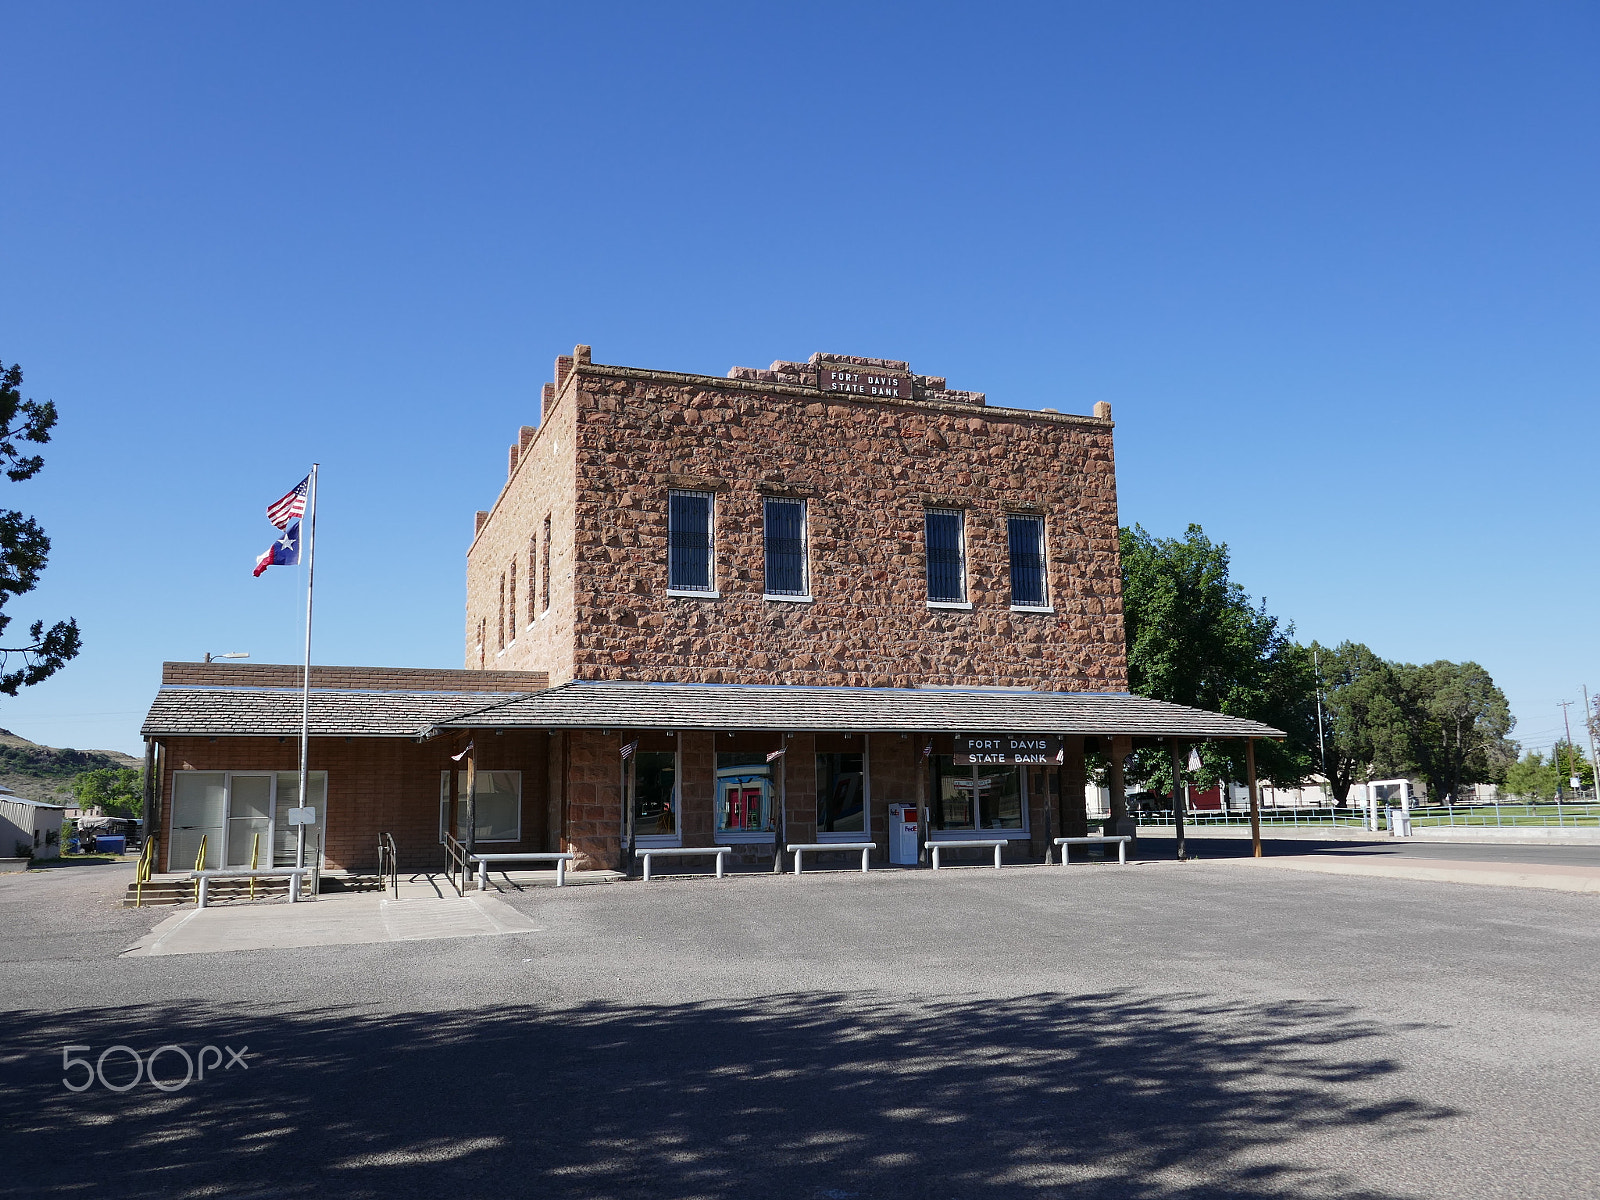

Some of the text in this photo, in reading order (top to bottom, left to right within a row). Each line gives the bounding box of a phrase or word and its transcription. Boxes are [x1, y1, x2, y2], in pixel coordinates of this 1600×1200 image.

[831, 372, 899, 387] FORT DAVIS
[831, 382, 900, 397] STATE BANK
[968, 740, 1047, 749] FORT DAVIS
[968, 753, 1047, 763] STATE BANK
